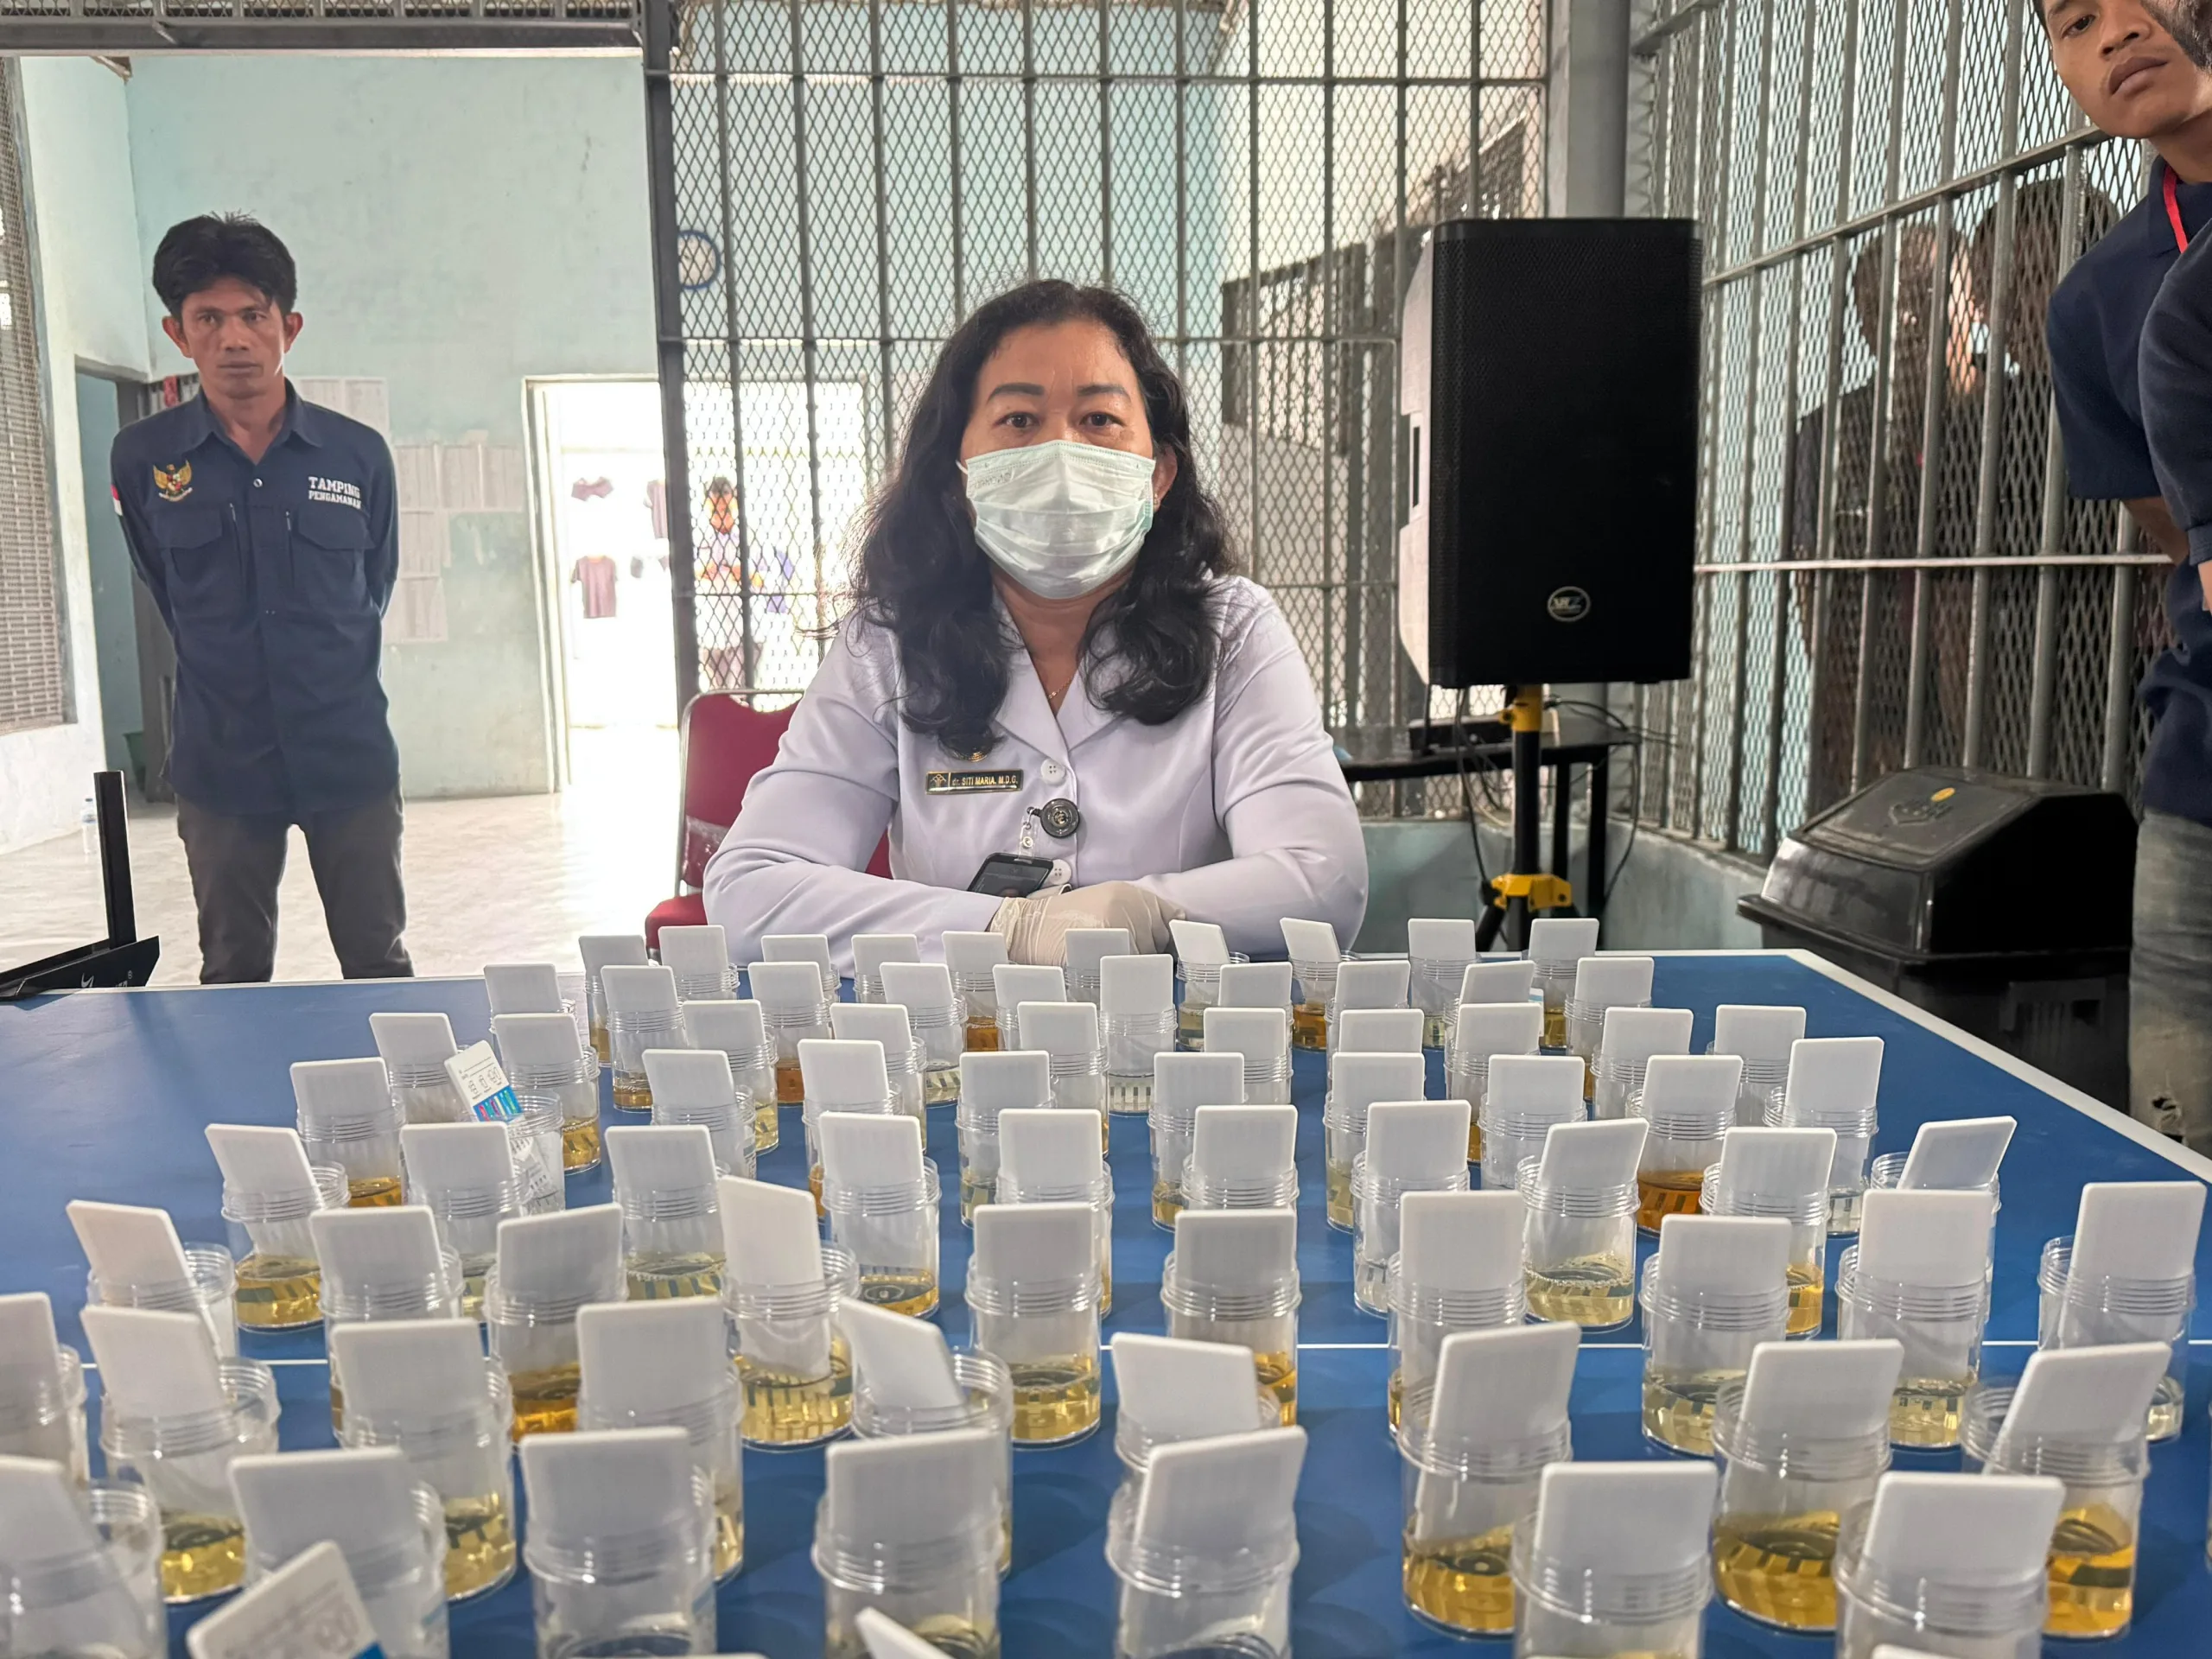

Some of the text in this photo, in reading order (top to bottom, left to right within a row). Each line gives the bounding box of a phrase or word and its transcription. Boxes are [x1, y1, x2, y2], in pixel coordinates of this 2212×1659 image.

[308, 476, 360, 499] TAMPING
[308, 489, 362, 509] PENGAMANAN
[962, 777, 974, 786] SITI
